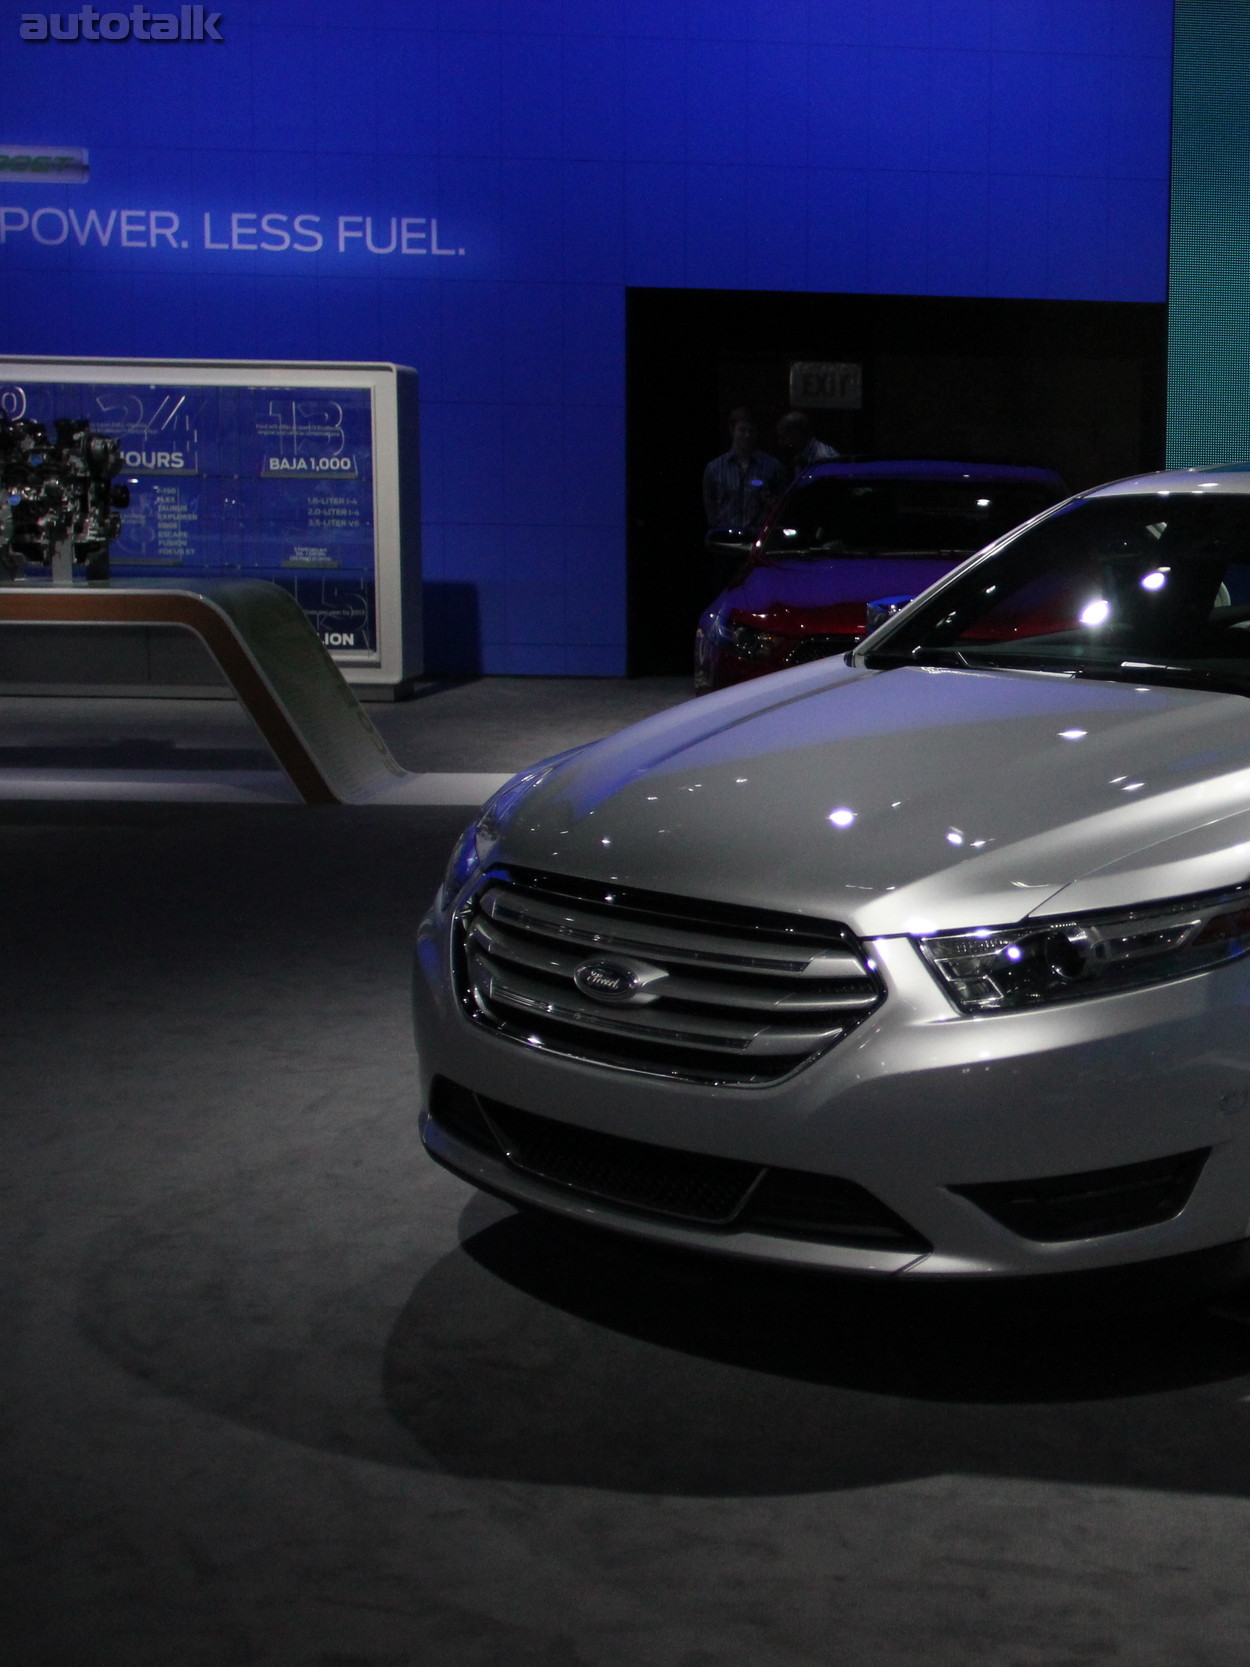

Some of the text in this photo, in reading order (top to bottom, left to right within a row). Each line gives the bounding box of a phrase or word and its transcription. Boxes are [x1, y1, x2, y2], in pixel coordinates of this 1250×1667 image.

[0, 206, 466, 256] POWER. LESS FUEL.
[120, 450, 185, 469] OURS
[269, 457, 351, 473] BAJA 1,000
